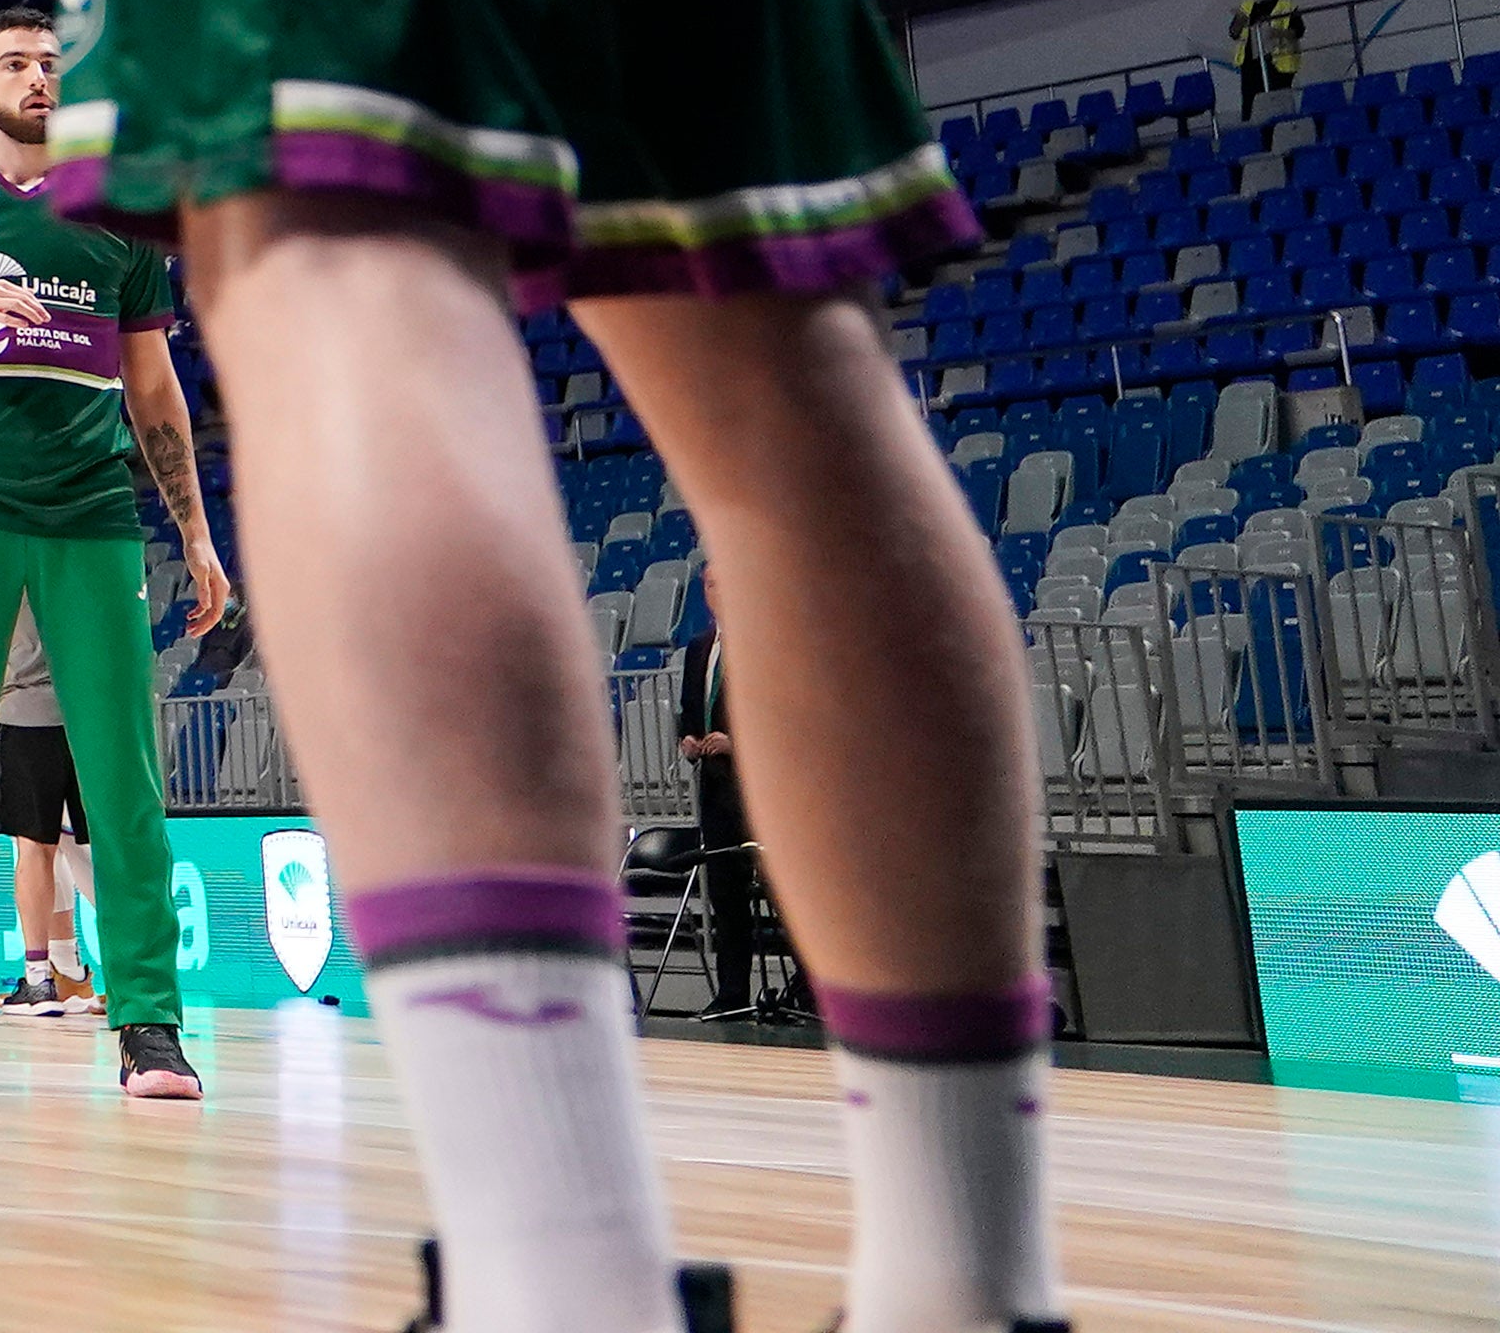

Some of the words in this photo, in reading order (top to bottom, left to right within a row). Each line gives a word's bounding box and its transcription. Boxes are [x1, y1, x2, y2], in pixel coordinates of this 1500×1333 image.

[21, 276, 97, 306] Unicaja
[17, 326, 53, 339] COSTA
[53, 329, 72, 343] DEL
[73, 334, 92, 347] SOL
